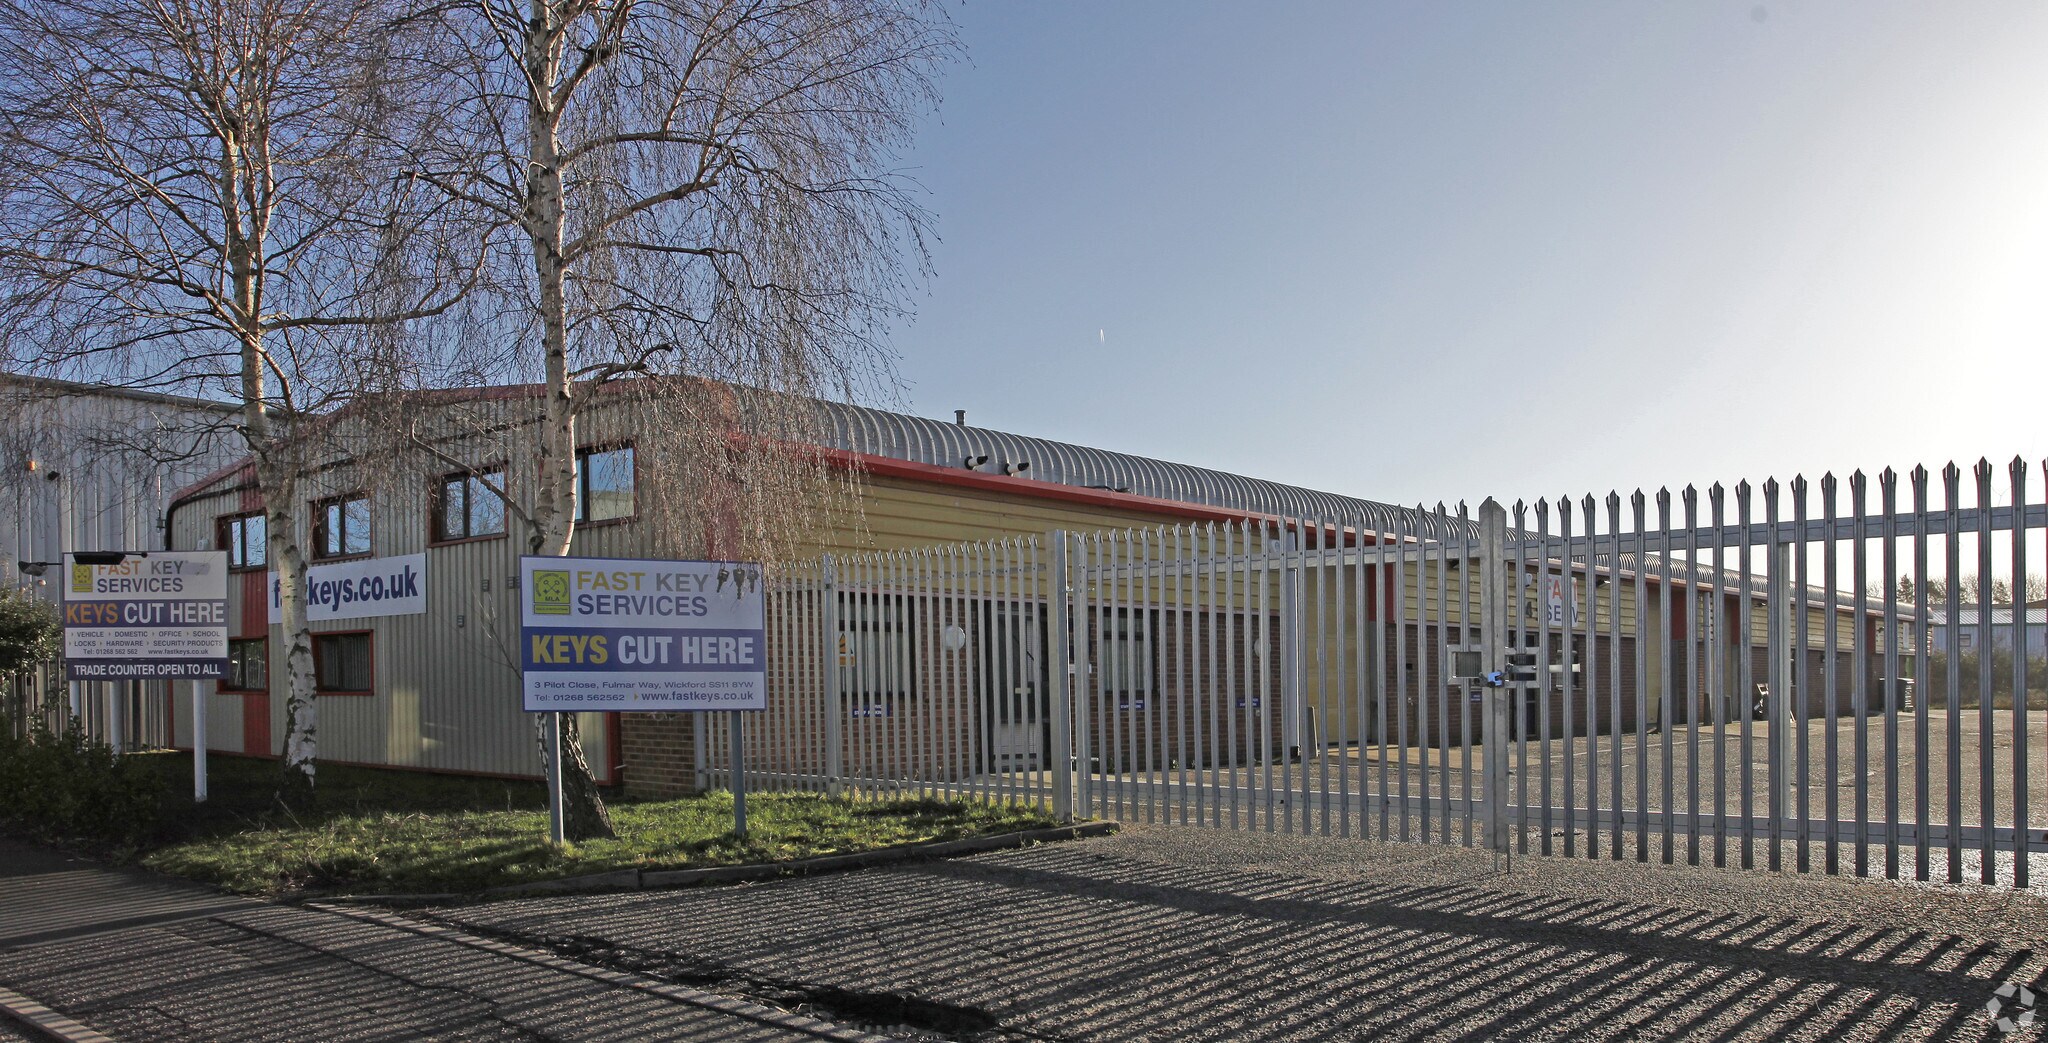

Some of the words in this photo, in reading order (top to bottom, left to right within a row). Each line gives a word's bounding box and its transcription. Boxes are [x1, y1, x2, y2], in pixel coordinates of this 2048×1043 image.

[97, 560, 142, 576] FAST
[151, 560, 184, 575] KEY
[97, 577, 184, 593] SERVICES
[273, 565, 418, 612] fkeys.co.uk
[577, 571, 646, 592] FAST
[656, 573, 710, 593] KEY
[66, 603, 119, 624] KEYS
[124, 602, 164, 624] CUT
[170, 602, 225, 623] HERE
[577, 594, 708, 617] SERVICES
[532, 635, 609, 665] KEYS
[617, 635, 673, 665] CUT
[682, 636, 755, 665] HERE
[74, 665, 106, 676] TRADE
[108, 665, 155, 676] COUNTER
[157, 664, 185, 675] OPEN
[187, 664, 200, 675] TO
[202, 664, 221, 675] ALL
[568, 682, 599, 690] Close,
[638, 682, 661, 690] Way,
[641, 691, 754, 702] www.fastkeys.co.uk
